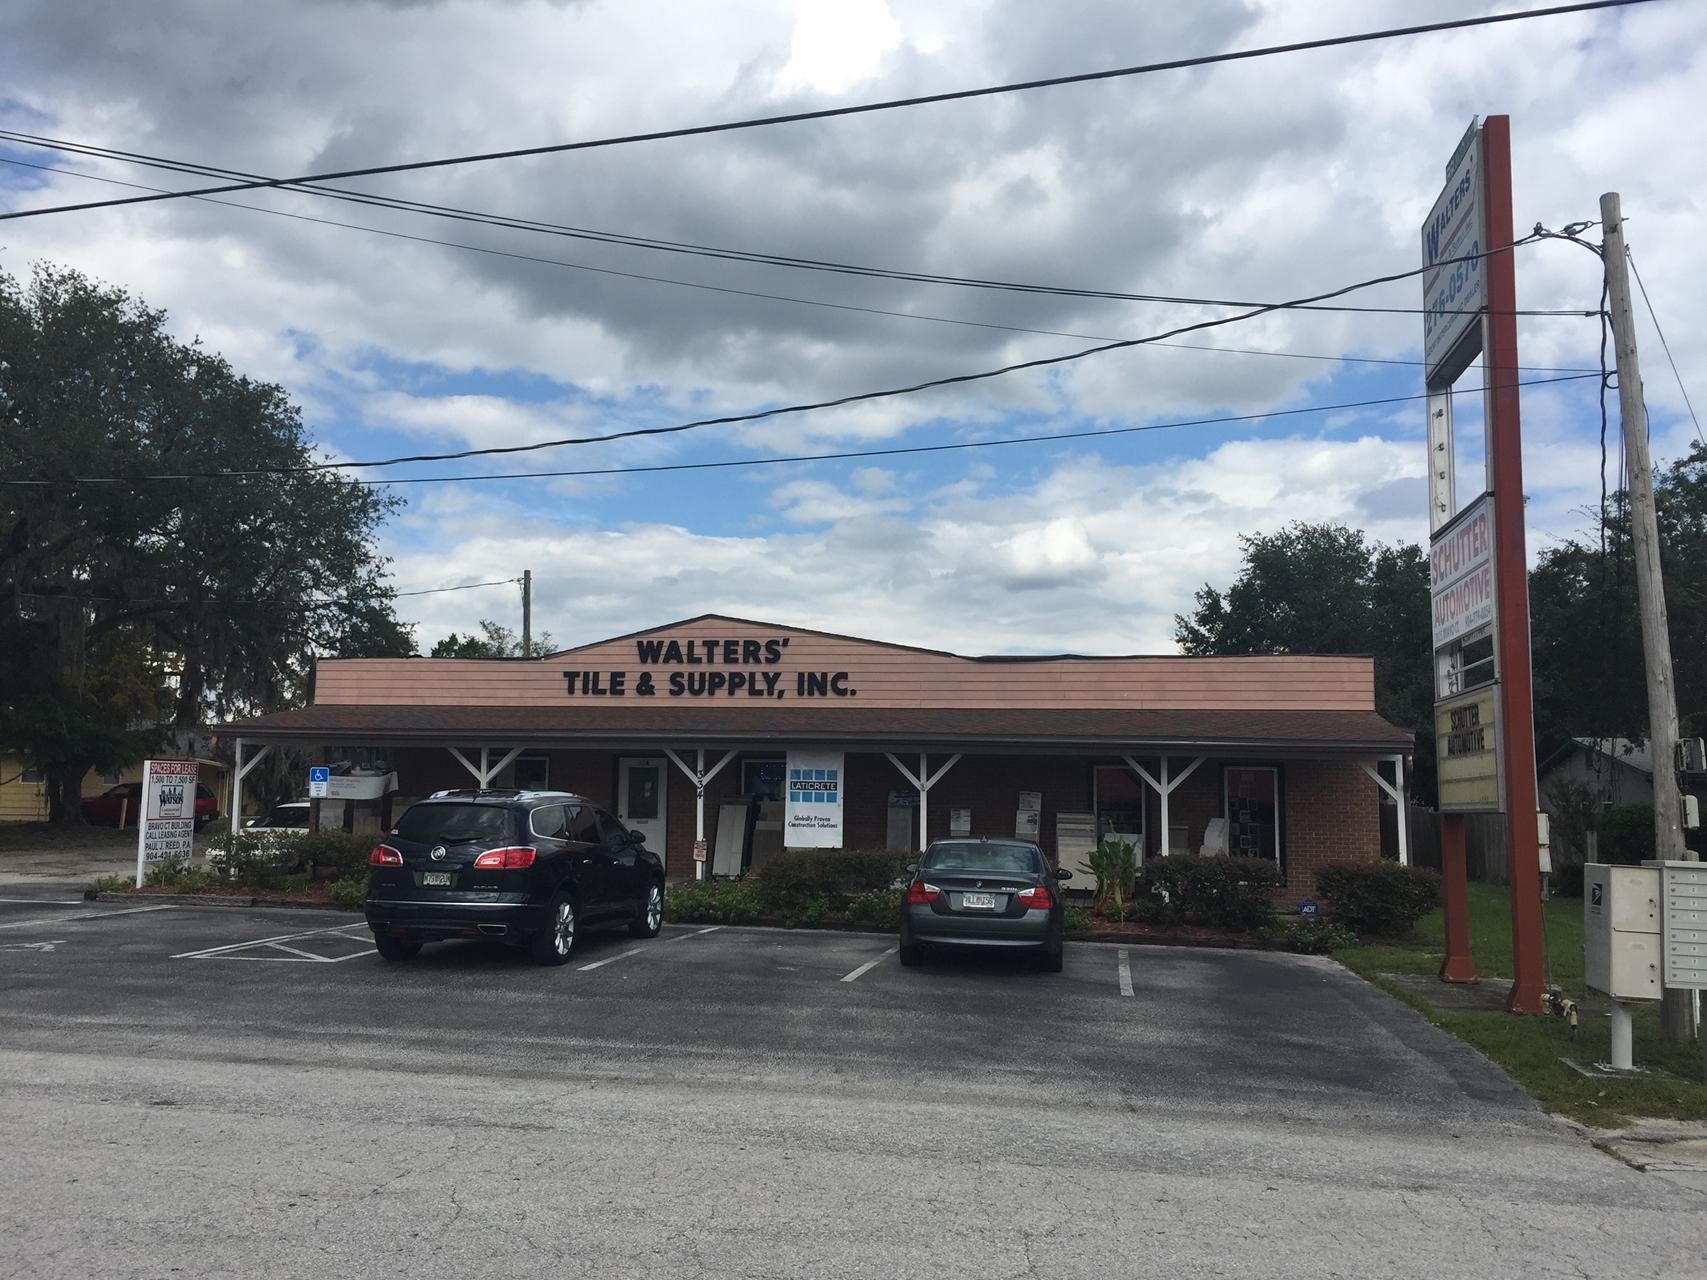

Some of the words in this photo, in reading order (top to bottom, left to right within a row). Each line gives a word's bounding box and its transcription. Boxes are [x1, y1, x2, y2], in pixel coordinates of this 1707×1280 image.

[1427, 240, 1479, 338] 276-0570
[1432, 513, 1488, 586] SCHUTTER
[1434, 567, 1490, 627] AUTOMOTIVE
[637, 638, 789, 664] WALTERS'
[563, 672, 626, 695] TILE
[636, 672, 656, 696] &
[669, 672, 785, 699] SUPPLY,
[797, 672, 857, 696] INC.
[150, 763, 171, 774] SPACES
[171, 764, 181, 774] FOR
[182, 764, 197, 774] LEASE
[151, 775, 165, 784] 1,500
[166, 776, 173, 784] TO
[174, 775, 188, 784] 7,500
[791, 782, 836, 790] LATICRETE
[794, 815, 813, 823] Globally
[148, 822, 164, 831] BRAVO
[164, 821, 171, 830] CT
[171, 821, 192, 830] BUILDING
[145, 831, 157, 840] CALL
[158, 830, 177, 839] LEASING
[178, 829, 192, 838] AGENT
[145, 842, 158, 851] PAUL
[1302, 905, 1316, 913] ADT
